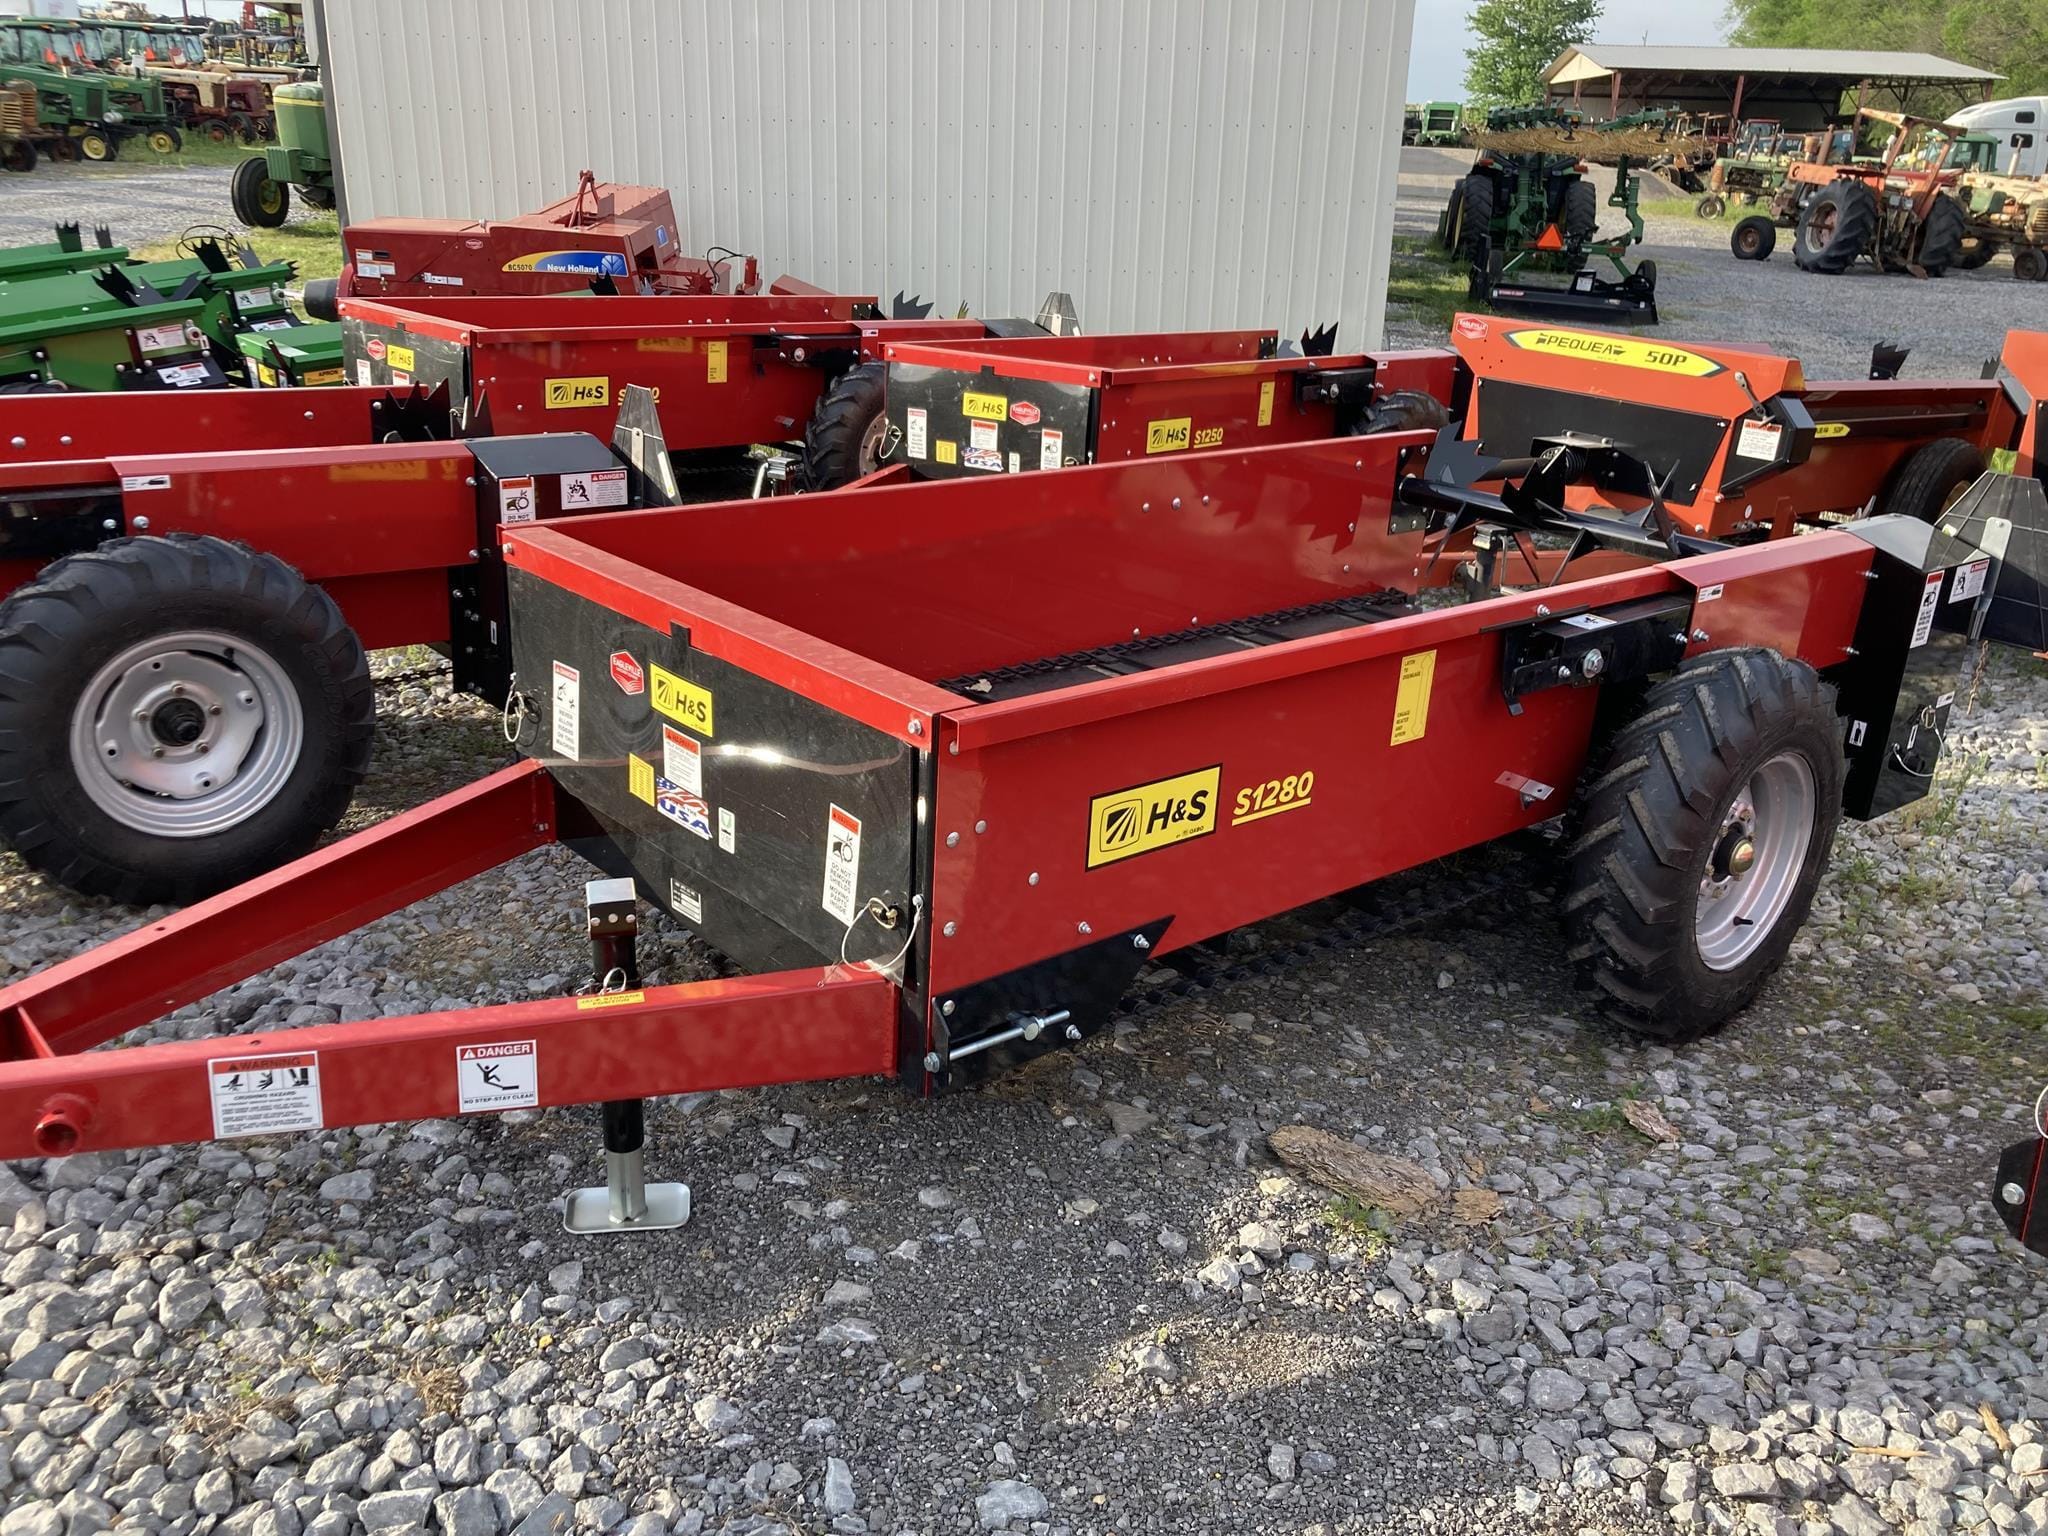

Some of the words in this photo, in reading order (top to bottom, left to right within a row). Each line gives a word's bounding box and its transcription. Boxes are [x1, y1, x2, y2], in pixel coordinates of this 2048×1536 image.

[547, 263, 565, 272] New
[567, 264, 599, 274] Holland
[1546, 337, 1613, 355] PEQUEA
[1644, 350, 1687, 367] 50P
[573, 385, 604, 401] H&S
[981, 402, 1003, 415] H&S
[1166, 427, 1188, 444] H&S
[1194, 427, 1224, 445] S1250
[967, 458, 1003, 470] USA
[612, 656, 642, 677] EAGLEVILLE
[675, 691, 706, 723] H&S
[1233, 771, 1314, 816] S1280
[659, 798, 710, 835] USA
[1145, 789, 1209, 835] H&S
[476, 1043, 530, 1058] DANGER
[240, 1057, 300, 1070] WARNING
[512, 1092, 534, 1100] CLEAR
